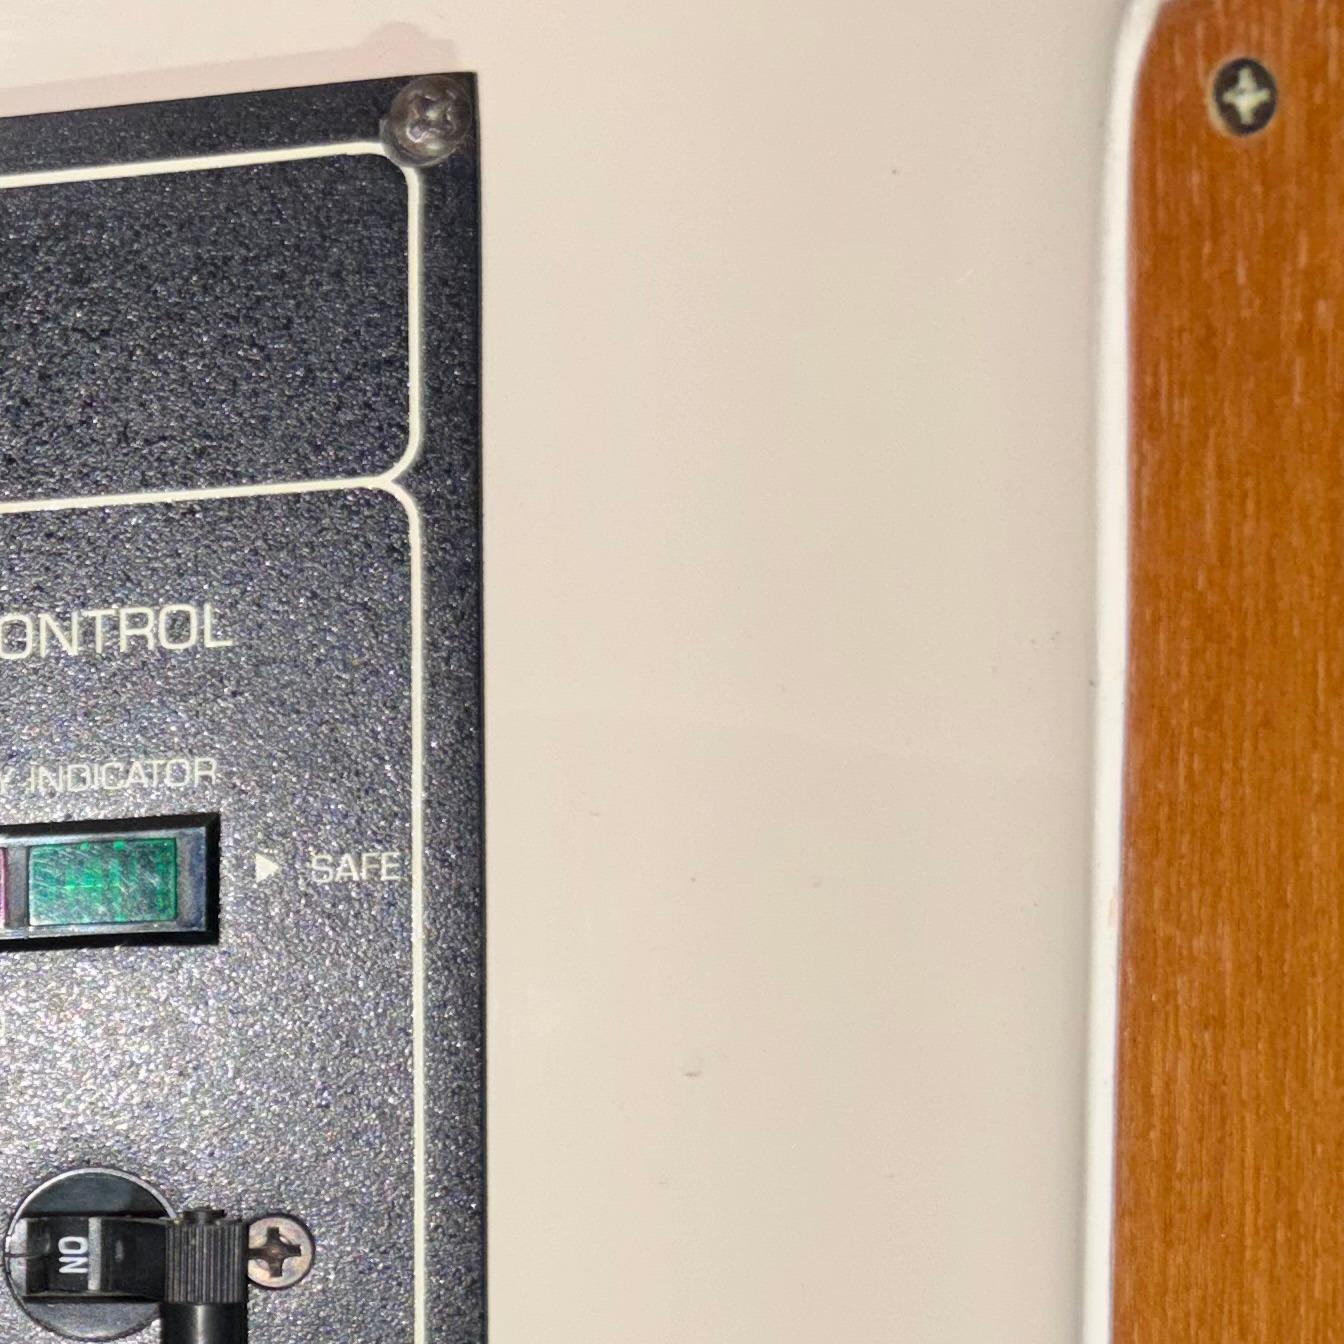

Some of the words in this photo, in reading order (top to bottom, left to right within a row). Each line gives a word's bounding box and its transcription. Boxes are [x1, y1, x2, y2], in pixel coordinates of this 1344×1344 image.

[27, 756, 218, 795] INDICATOR
[310, 851, 401, 884] SAFE
[59, 1235, 89, 1275] ON
